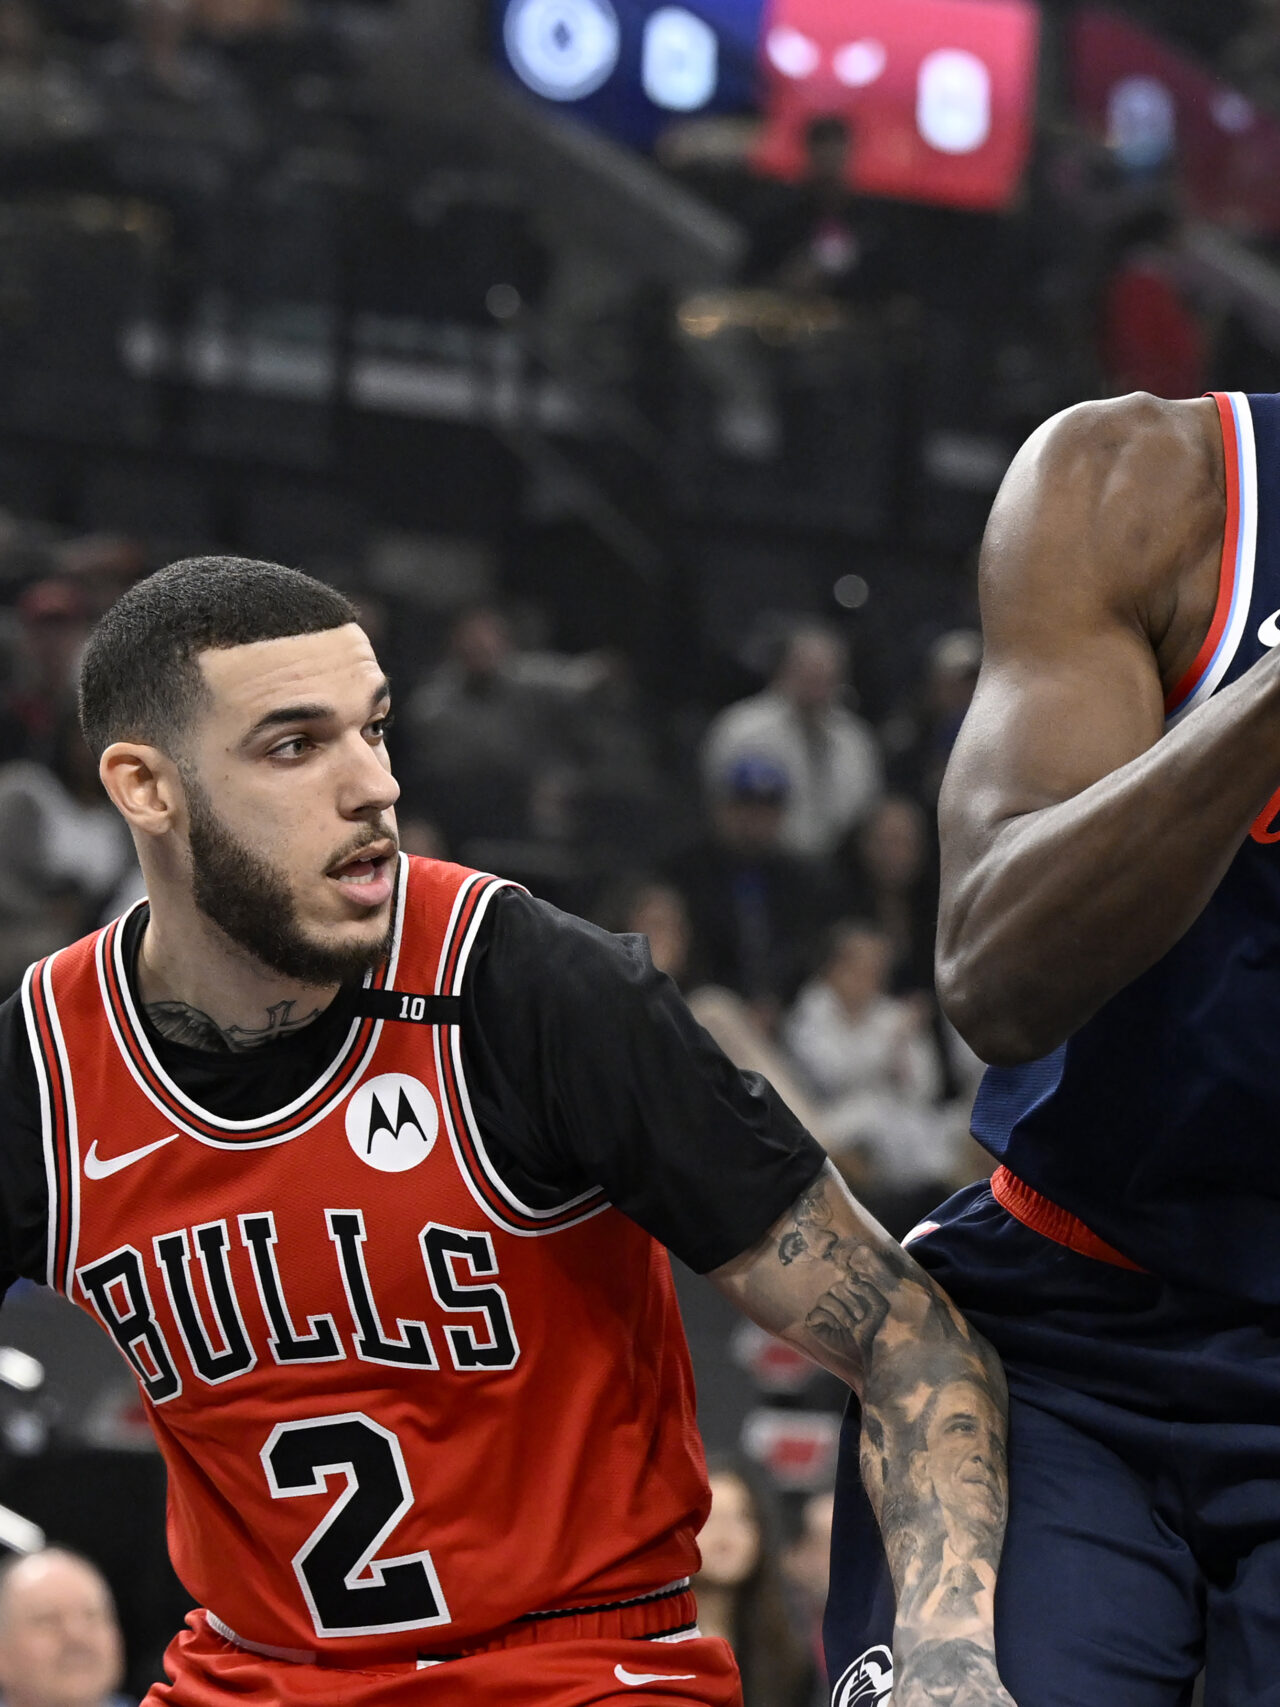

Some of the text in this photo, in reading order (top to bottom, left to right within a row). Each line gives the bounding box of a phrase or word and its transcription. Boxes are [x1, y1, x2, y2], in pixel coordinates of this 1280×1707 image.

[399, 995, 426, 1021] 10
[75, 1208, 521, 1407] BULLS
[259, 1411, 452, 1639] 2
